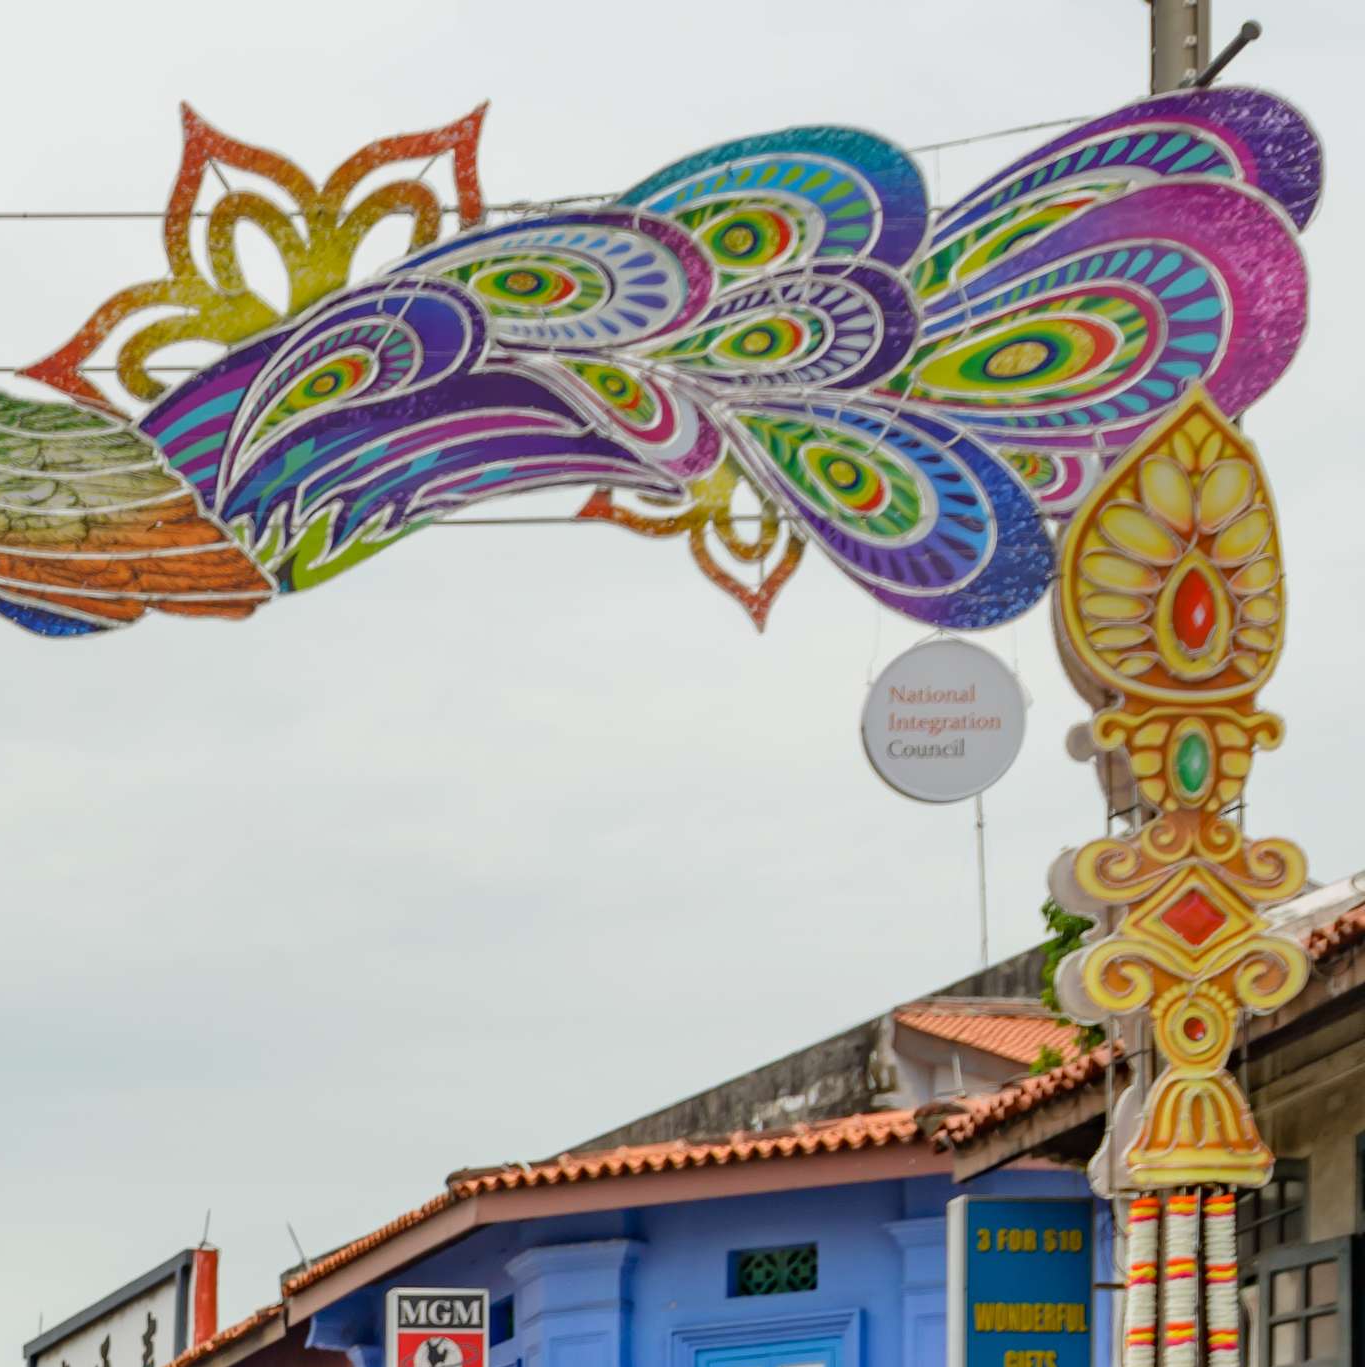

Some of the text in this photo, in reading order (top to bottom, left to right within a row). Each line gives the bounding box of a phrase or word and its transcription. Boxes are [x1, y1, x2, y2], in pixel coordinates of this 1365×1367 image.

[888, 685, 975, 703] National
[888, 712, 1001, 736] Integration
[887, 738, 965, 759] Council
[976, 1228, 1083, 1252] 3 FOR $10
[400, 1300, 481, 1325] MGM
[975, 1303, 1088, 1333] WONDERFUL
